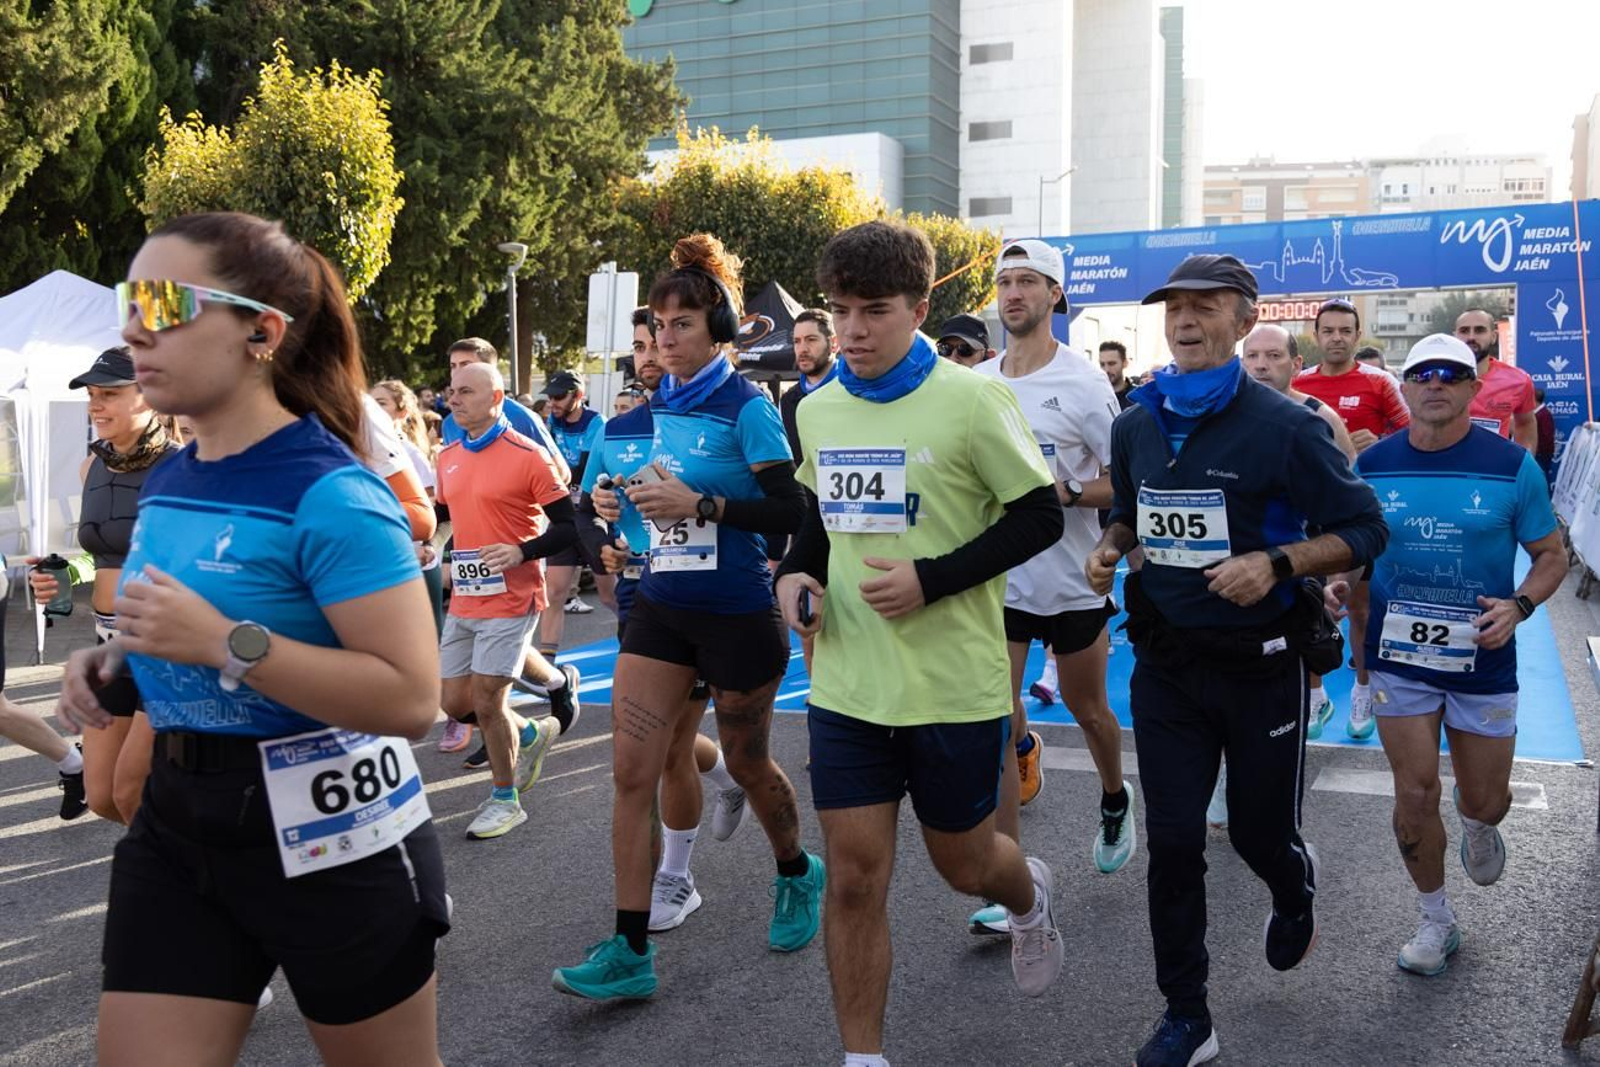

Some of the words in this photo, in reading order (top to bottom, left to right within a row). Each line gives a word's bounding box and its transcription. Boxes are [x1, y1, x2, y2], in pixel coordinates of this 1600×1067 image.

[1523, 226, 1570, 240] MEDIA
[1519, 238, 1592, 256] MARATÓN
[1073, 255, 1111, 267] MEDIA
[1514, 256, 1550, 272] JAÉN
[1070, 266, 1128, 281] MARATÓN
[1067, 281, 1096, 295] JAÉN
[1531, 373, 1553, 381] CAJA
[1555, 372, 1585, 381] RURAL
[1212, 469, 1239, 479] Columbia
[829, 472, 886, 501] 304
[1149, 512, 1208, 539] 305
[458, 563, 490, 579] 896
[1410, 621, 1450, 646] 82
[1269, 720, 1296, 738] adidas
[311, 745, 401, 815] 680
